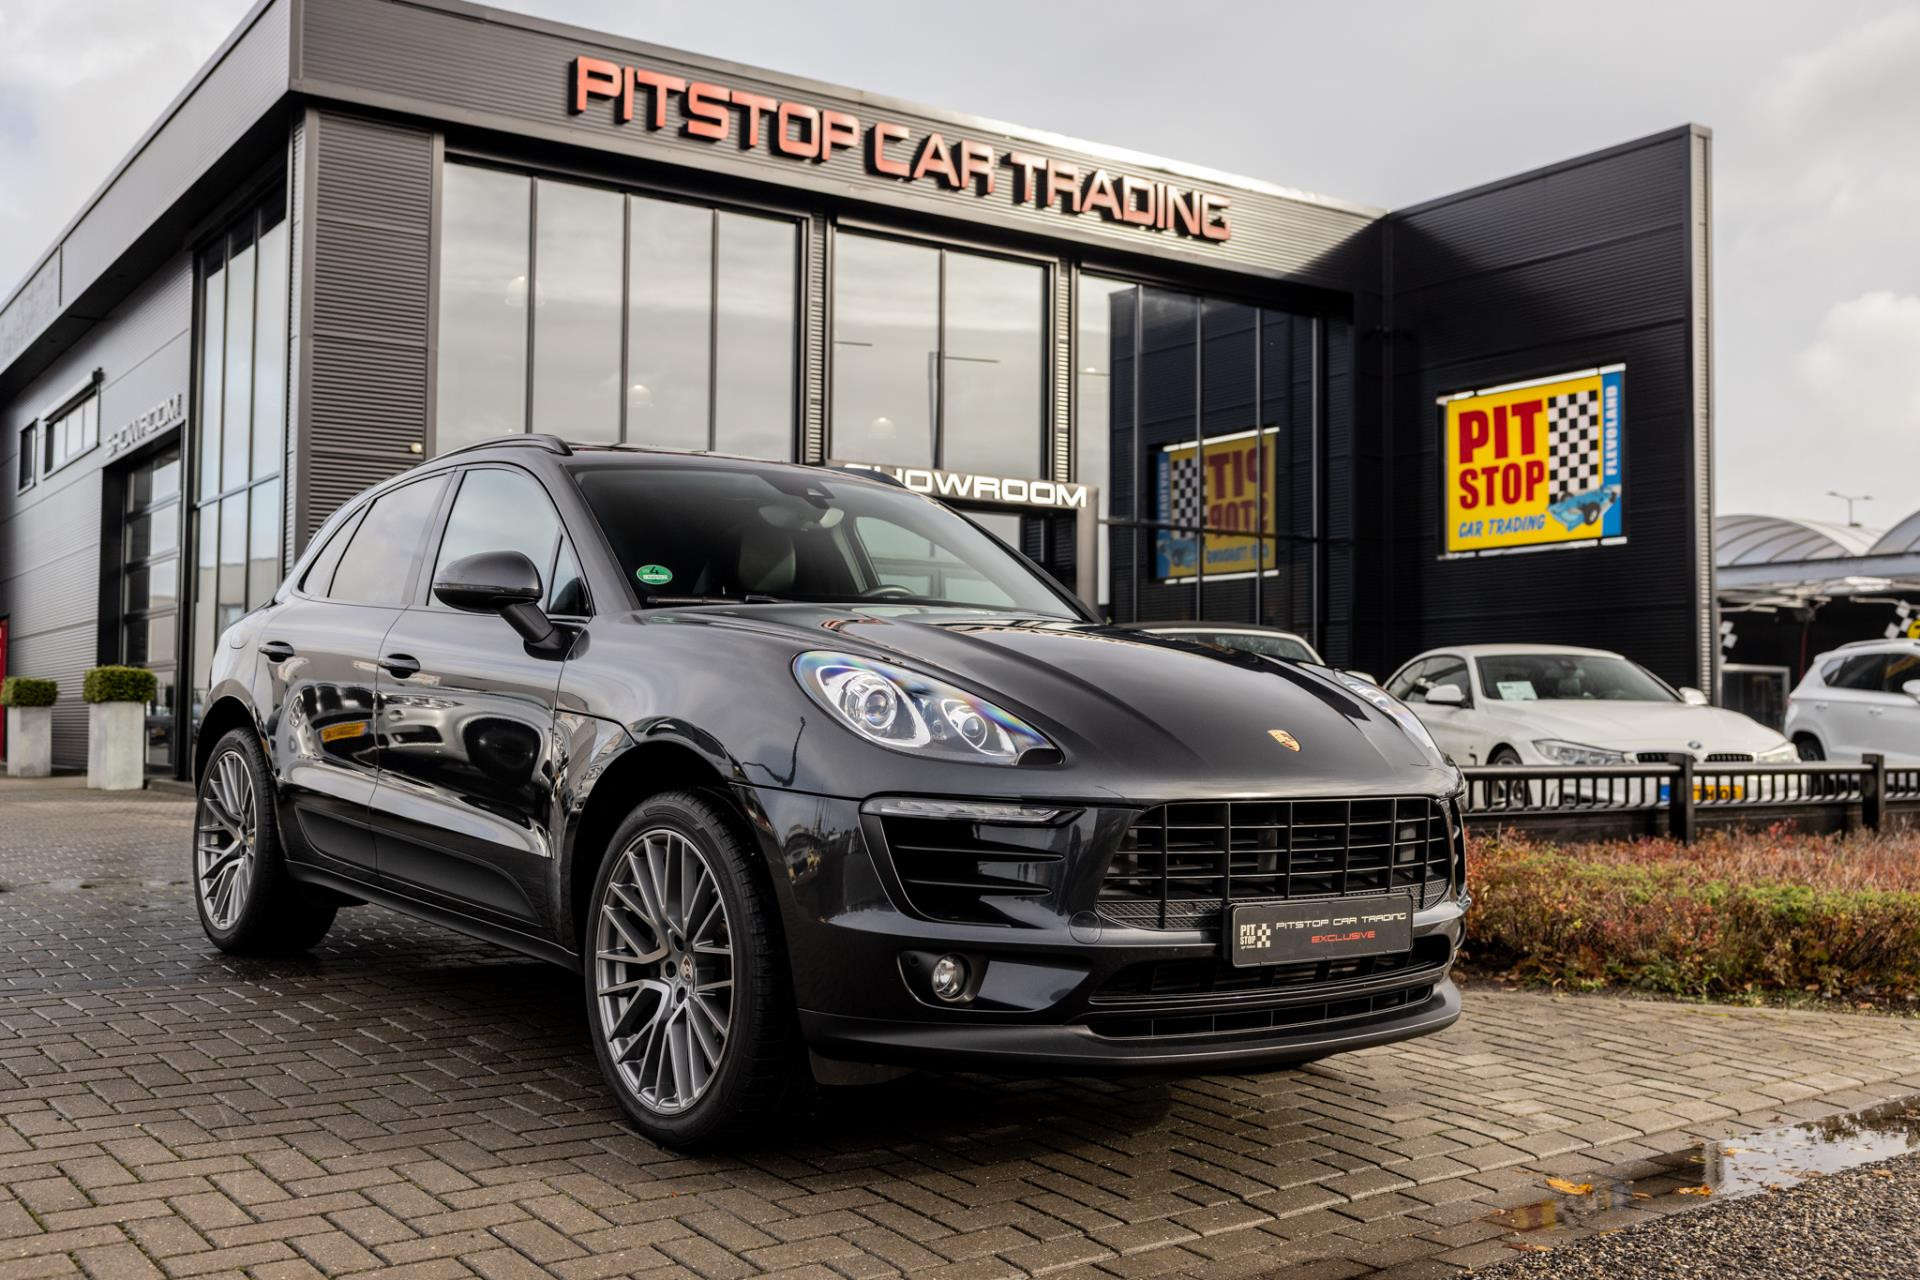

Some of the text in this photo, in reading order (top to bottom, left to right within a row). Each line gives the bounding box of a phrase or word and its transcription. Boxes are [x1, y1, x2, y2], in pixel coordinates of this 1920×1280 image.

[572, 55, 1232, 241] PITSTOP CAR TRADING
[1458, 399, 1544, 465] PIT
[1604, 385, 1618, 476] FLEVOLAND
[844, 463, 1087, 508] OWROOM
[1458, 459, 1545, 510] STOP
[1458, 514, 1546, 538] CAR TRADING
[1240, 923, 1257, 937] PIT
[1276, 912, 1407, 930] PITSTOP CAR TRADING
[1311, 930, 1376, 943] EXCLUSIVE
[1239, 935, 1257, 946] STOP
